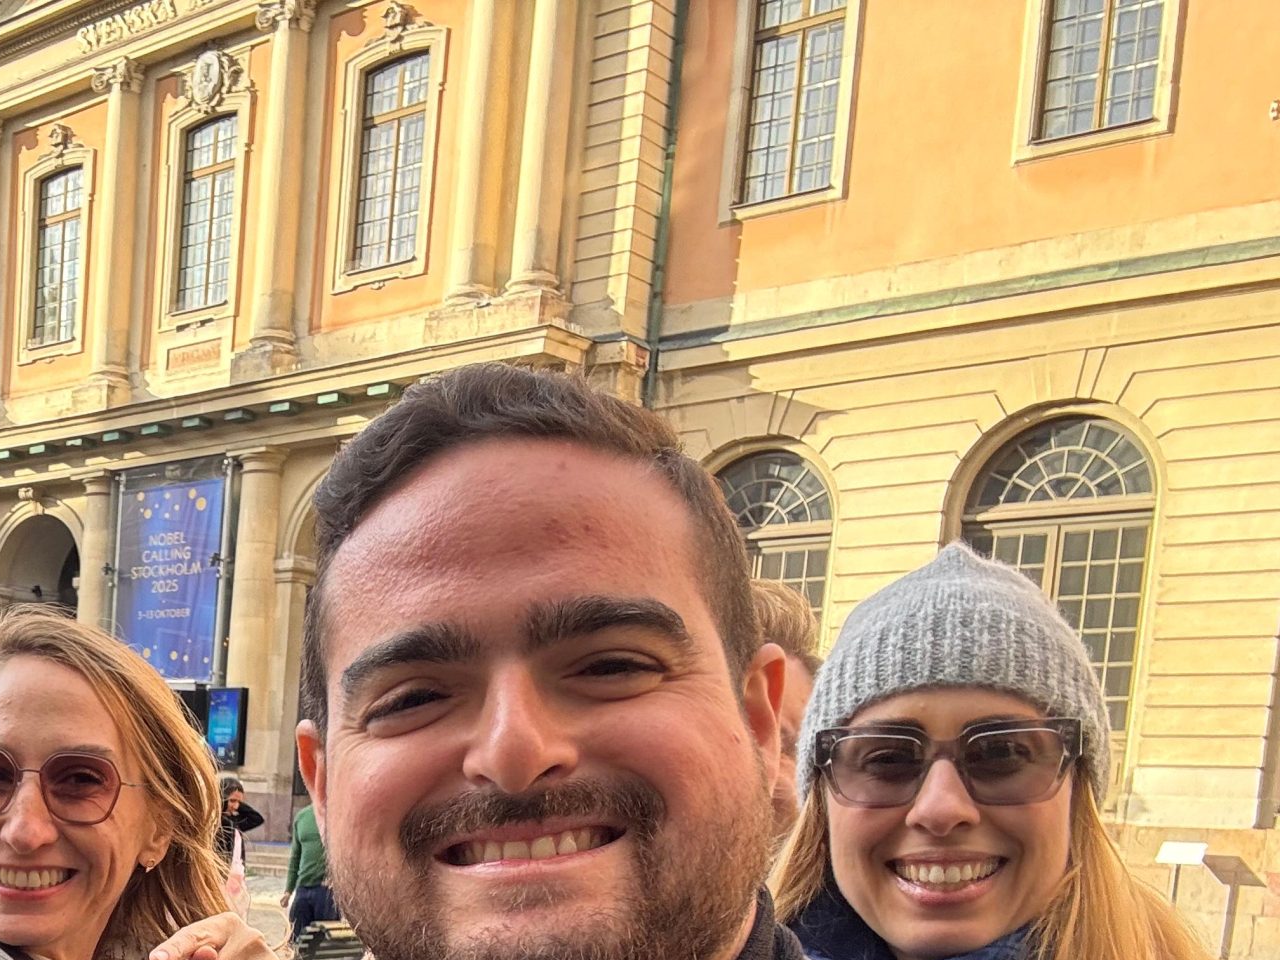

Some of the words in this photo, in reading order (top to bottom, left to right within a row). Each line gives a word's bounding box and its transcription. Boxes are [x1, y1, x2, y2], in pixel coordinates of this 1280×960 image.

[149, 532, 186, 546] NOBEL
[142, 546, 192, 563] CALLING
[130, 562, 202, 580] STOCKHOLM
[151, 580, 179, 593] 2025
[155, 608, 191, 619] OKTOBER
